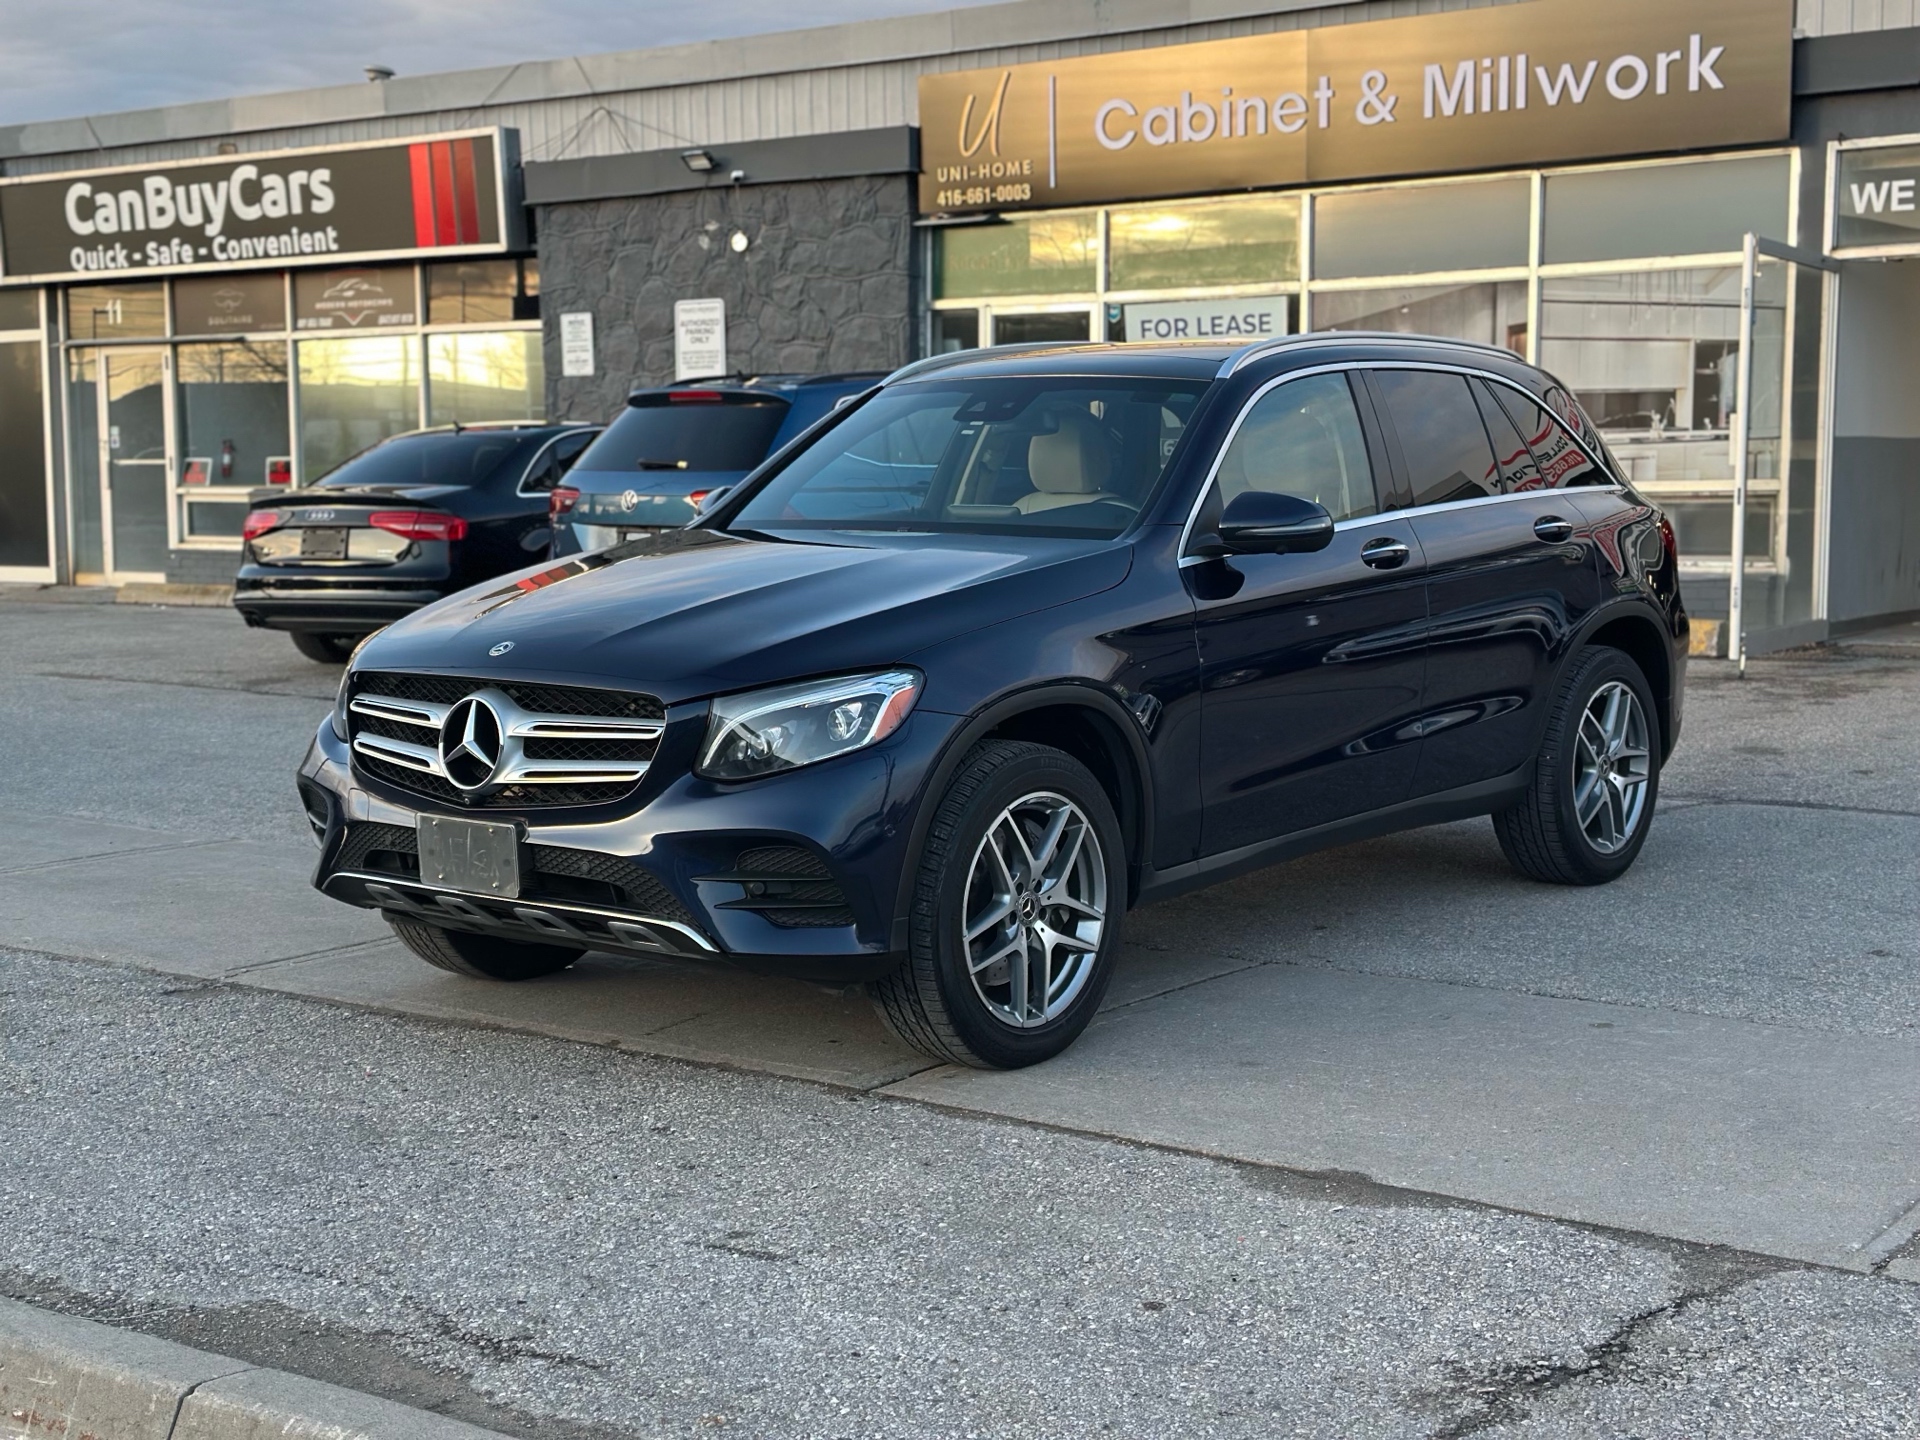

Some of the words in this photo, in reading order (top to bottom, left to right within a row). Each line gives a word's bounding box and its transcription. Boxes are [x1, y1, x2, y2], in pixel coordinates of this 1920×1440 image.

[1094, 76, 1336, 150] Cabinet
[1355, 69, 1397, 126] &
[1422, 33, 1726, 119] Millwork
[937, 159, 1034, 184] UNI-HOME
[64, 164, 335, 237] CanBuyCars
[937, 183, 1032, 208] 416-661-0003
[1850, 179, 1916, 214] WE
[69, 245, 129, 272] Quick
[145, 241, 194, 268] Safe
[212, 225, 339, 262] Convenient
[680, 318, 720, 327] AUTHORIZED
[685, 327, 715, 336] PARKING
[1140, 317, 1188, 338] FOR
[1197, 312, 1273, 336] LEASE
